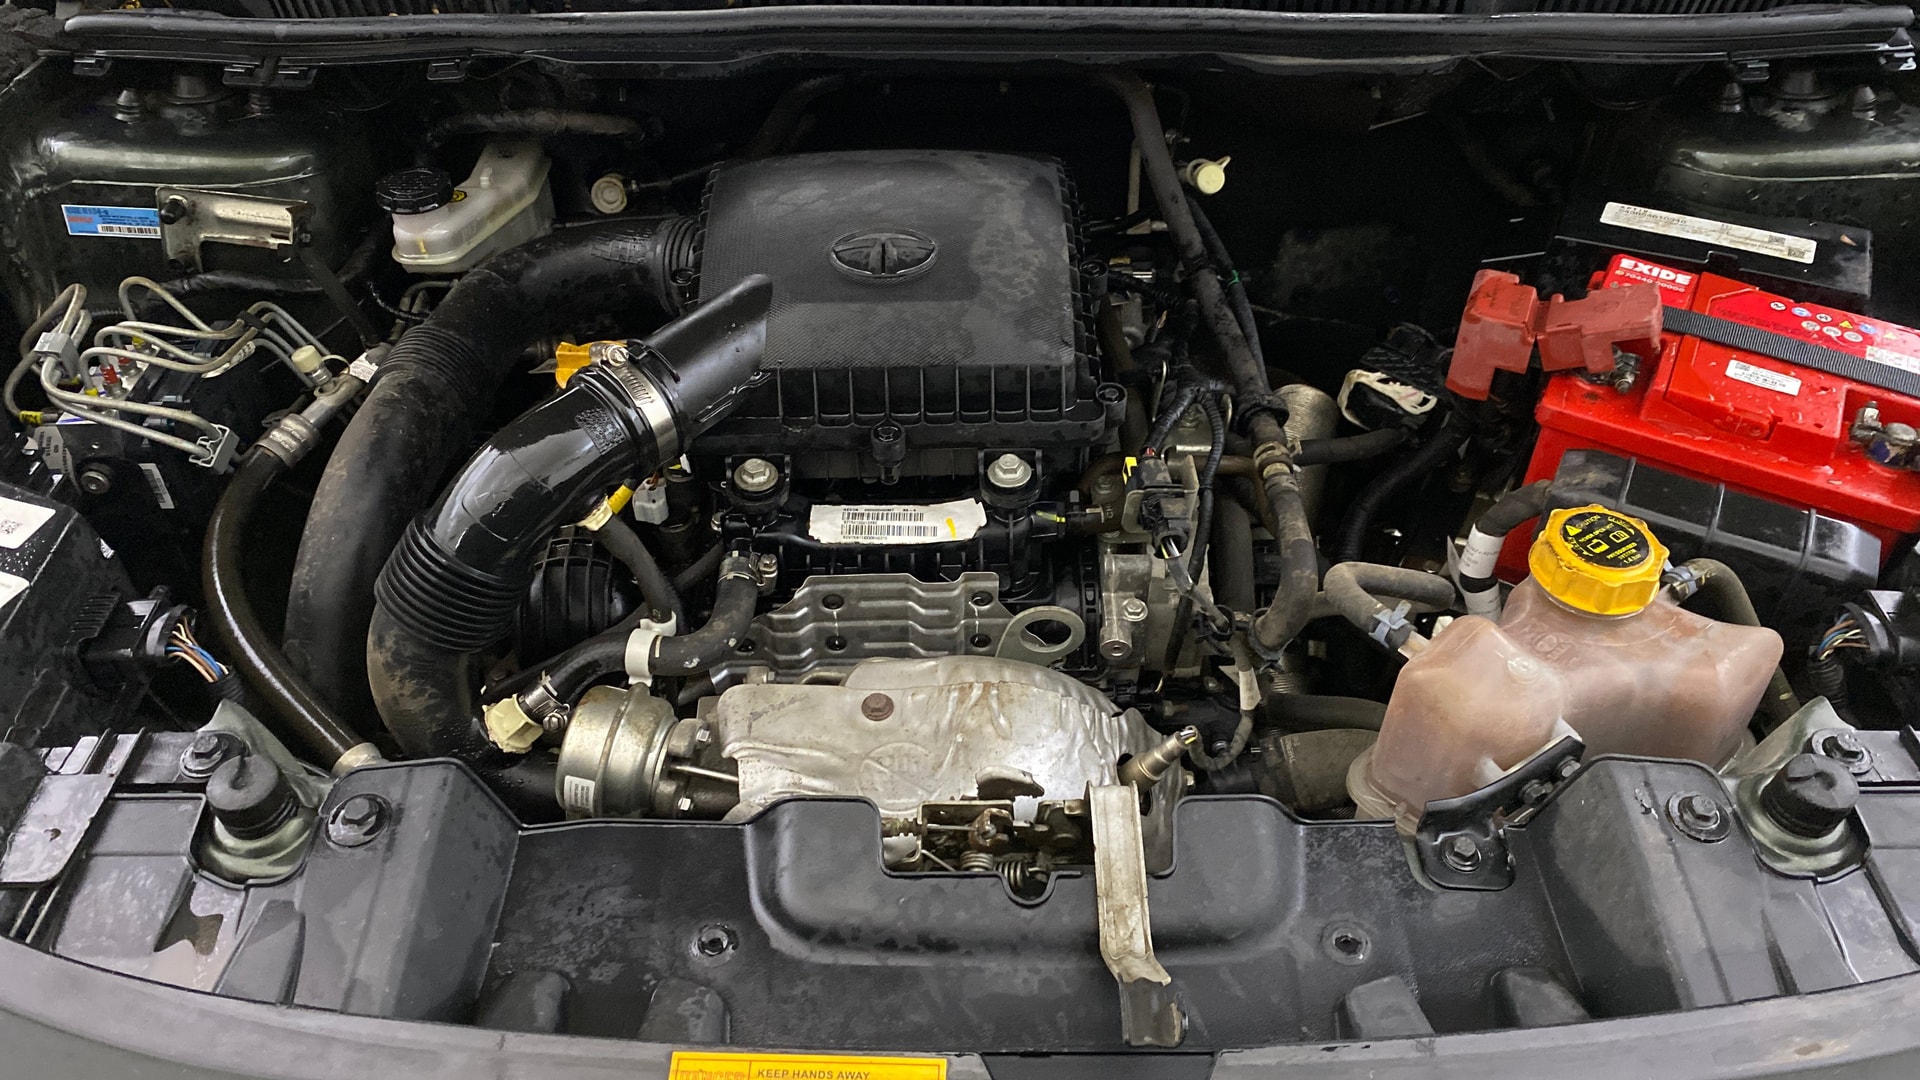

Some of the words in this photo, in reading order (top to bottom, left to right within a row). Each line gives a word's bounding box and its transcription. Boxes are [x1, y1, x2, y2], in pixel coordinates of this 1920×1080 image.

[1620, 258, 1692, 285] EXIDE
[757, 1068, 789, 1079] KEEP
[793, 1069, 834, 1080] HANDS
[837, 1071, 870, 1080] AWAY
